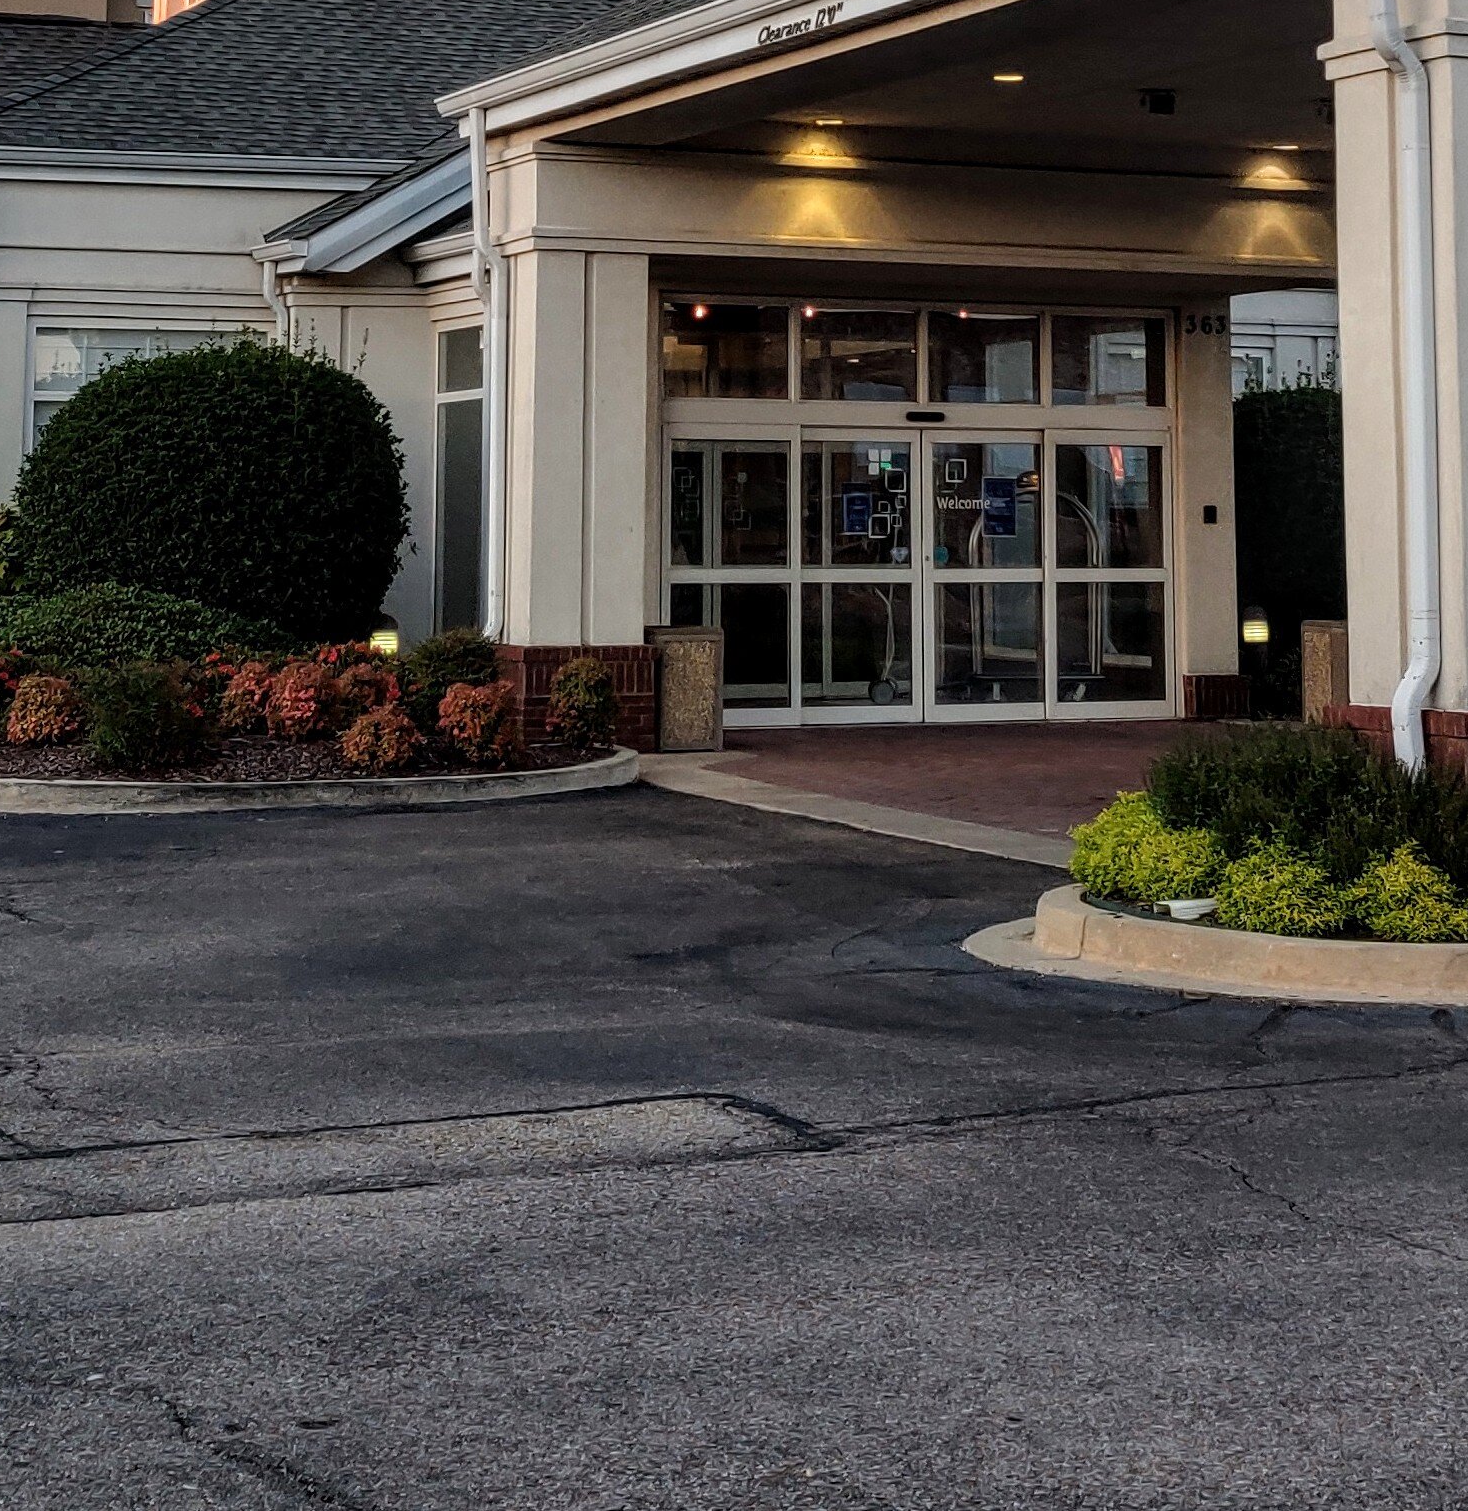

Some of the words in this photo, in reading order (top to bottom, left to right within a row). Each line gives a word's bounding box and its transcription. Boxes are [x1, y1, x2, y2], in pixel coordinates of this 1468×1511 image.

[758, 19, 811, 45] Clearance
[1185, 314, 1227, 335] 363
[936, 496, 991, 509] Welcome
